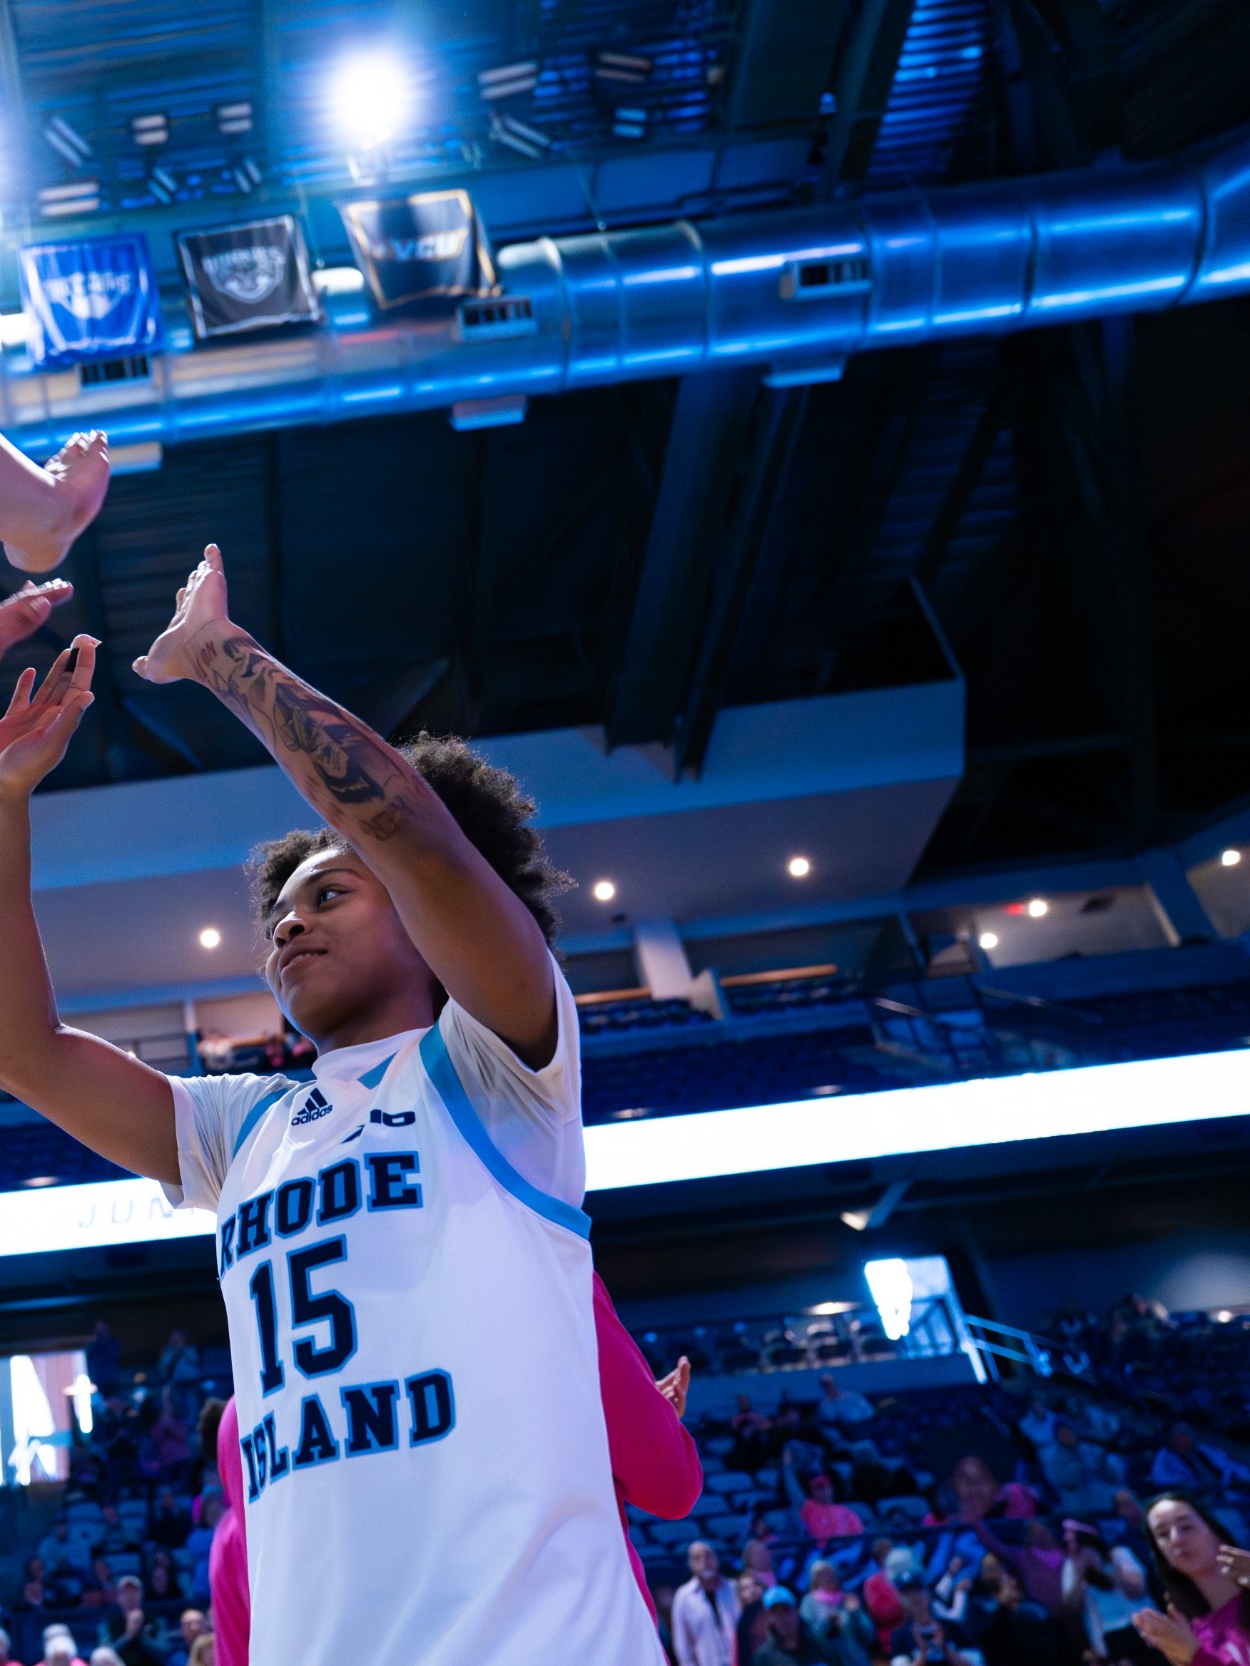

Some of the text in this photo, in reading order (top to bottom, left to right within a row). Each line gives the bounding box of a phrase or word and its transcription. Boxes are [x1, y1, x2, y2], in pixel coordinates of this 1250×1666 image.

[291, 1104, 333, 1127] adidas
[78, 1196, 196, 1228] JUN
[220, 1151, 424, 1278] RHODE
[250, 1233, 358, 1398] 15
[240, 1367, 456, 1504] ISLAND
